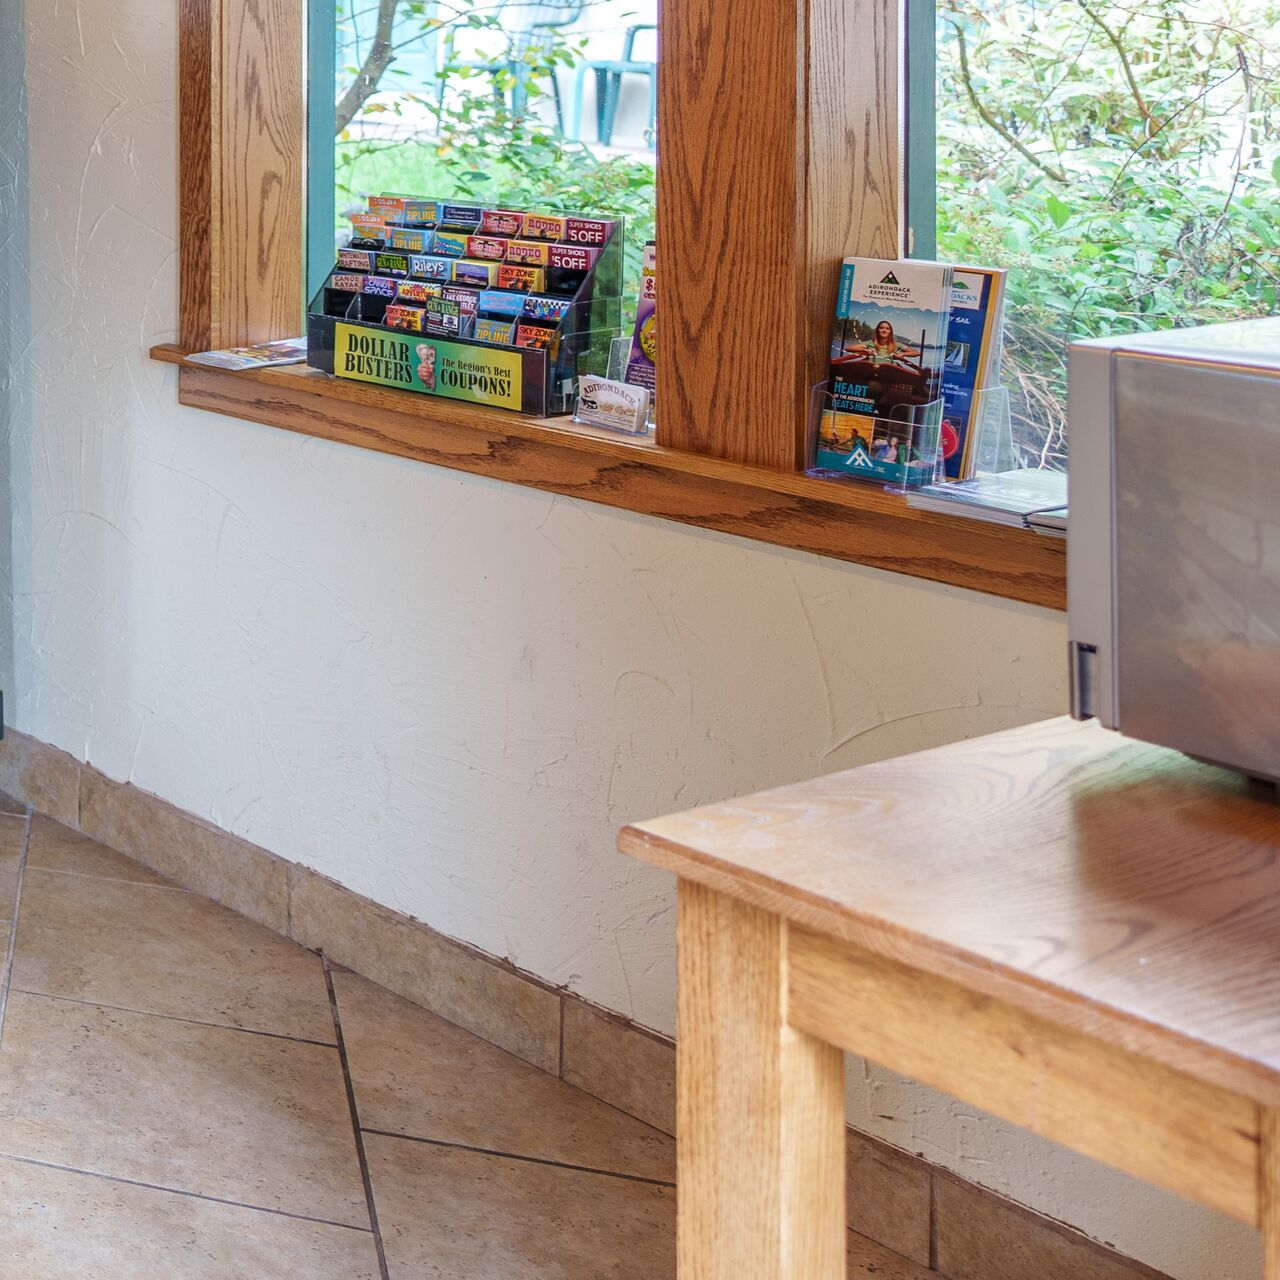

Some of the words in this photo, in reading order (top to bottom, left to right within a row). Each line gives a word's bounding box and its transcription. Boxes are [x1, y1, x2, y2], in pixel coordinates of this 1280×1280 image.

[406, 210, 437, 220] ZIPLINE
[528, 218, 560, 232] RODEO
[584, 222, 602, 230] SHOES
[568, 230, 578, 241] $5
[578, 231, 603, 243] OFF
[393, 239, 422, 251] ZIPLINE
[552, 247, 567, 255] SUPER
[509, 246, 541, 257] RODEO
[391, 260, 407, 270] RANGE
[413, 260, 445, 272] Rileys
[551, 256, 561, 267] $5
[561, 258, 586, 270] OFF
[501, 268, 516, 276] SKY
[516, 269, 536, 278] ZONE
[364, 287, 394, 297] SPACE
[868, 284, 911, 293] ADIRONDACK
[869, 290, 909, 298] EXPERIENCE
[442, 293, 456, 301] LAKE
[456, 294, 477, 304] GEORGE
[386, 306, 398, 315] SKY
[399, 309, 418, 318] ZONE
[426, 301, 438, 312] GUN
[441, 304, 459, 316] RANGE
[476, 329, 507, 344] ZIPLINE
[519, 326, 534, 335] SKY
[535, 328, 555, 339] ZONE
[347, 333, 410, 363] DOLLAR
[344, 352, 413, 384] BUSTERS
[442, 357, 455, 367] The
[457, 359, 492, 375] Region's
[494, 367, 511, 378] Best
[441, 370, 511, 397] COUPONS!
[833, 382, 869, 397] HEART
[583, 383, 636, 407] ADIRONDACK
[847, 395, 875, 404] ADIRONDACKS
[832, 400, 854, 409] BEATS
